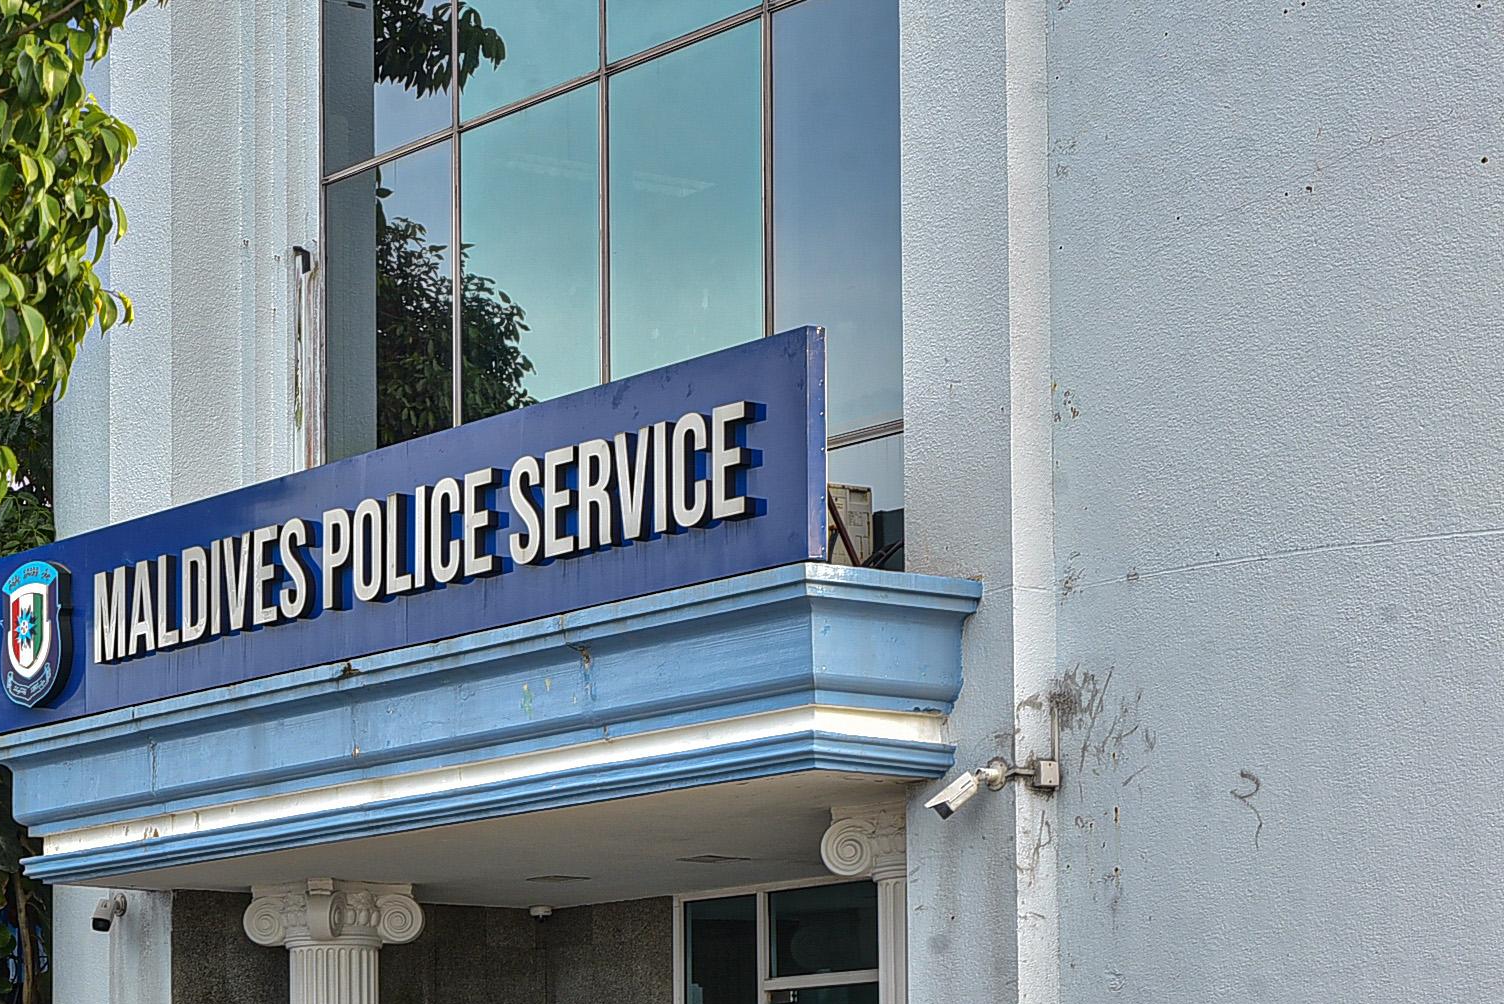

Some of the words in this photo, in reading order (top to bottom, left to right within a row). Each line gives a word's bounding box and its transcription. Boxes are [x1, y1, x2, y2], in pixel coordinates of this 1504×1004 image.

[93, 517, 309, 664] MALDIVES
[322, 467, 494, 609] POLICE
[508, 400, 747, 566] SERVICE
